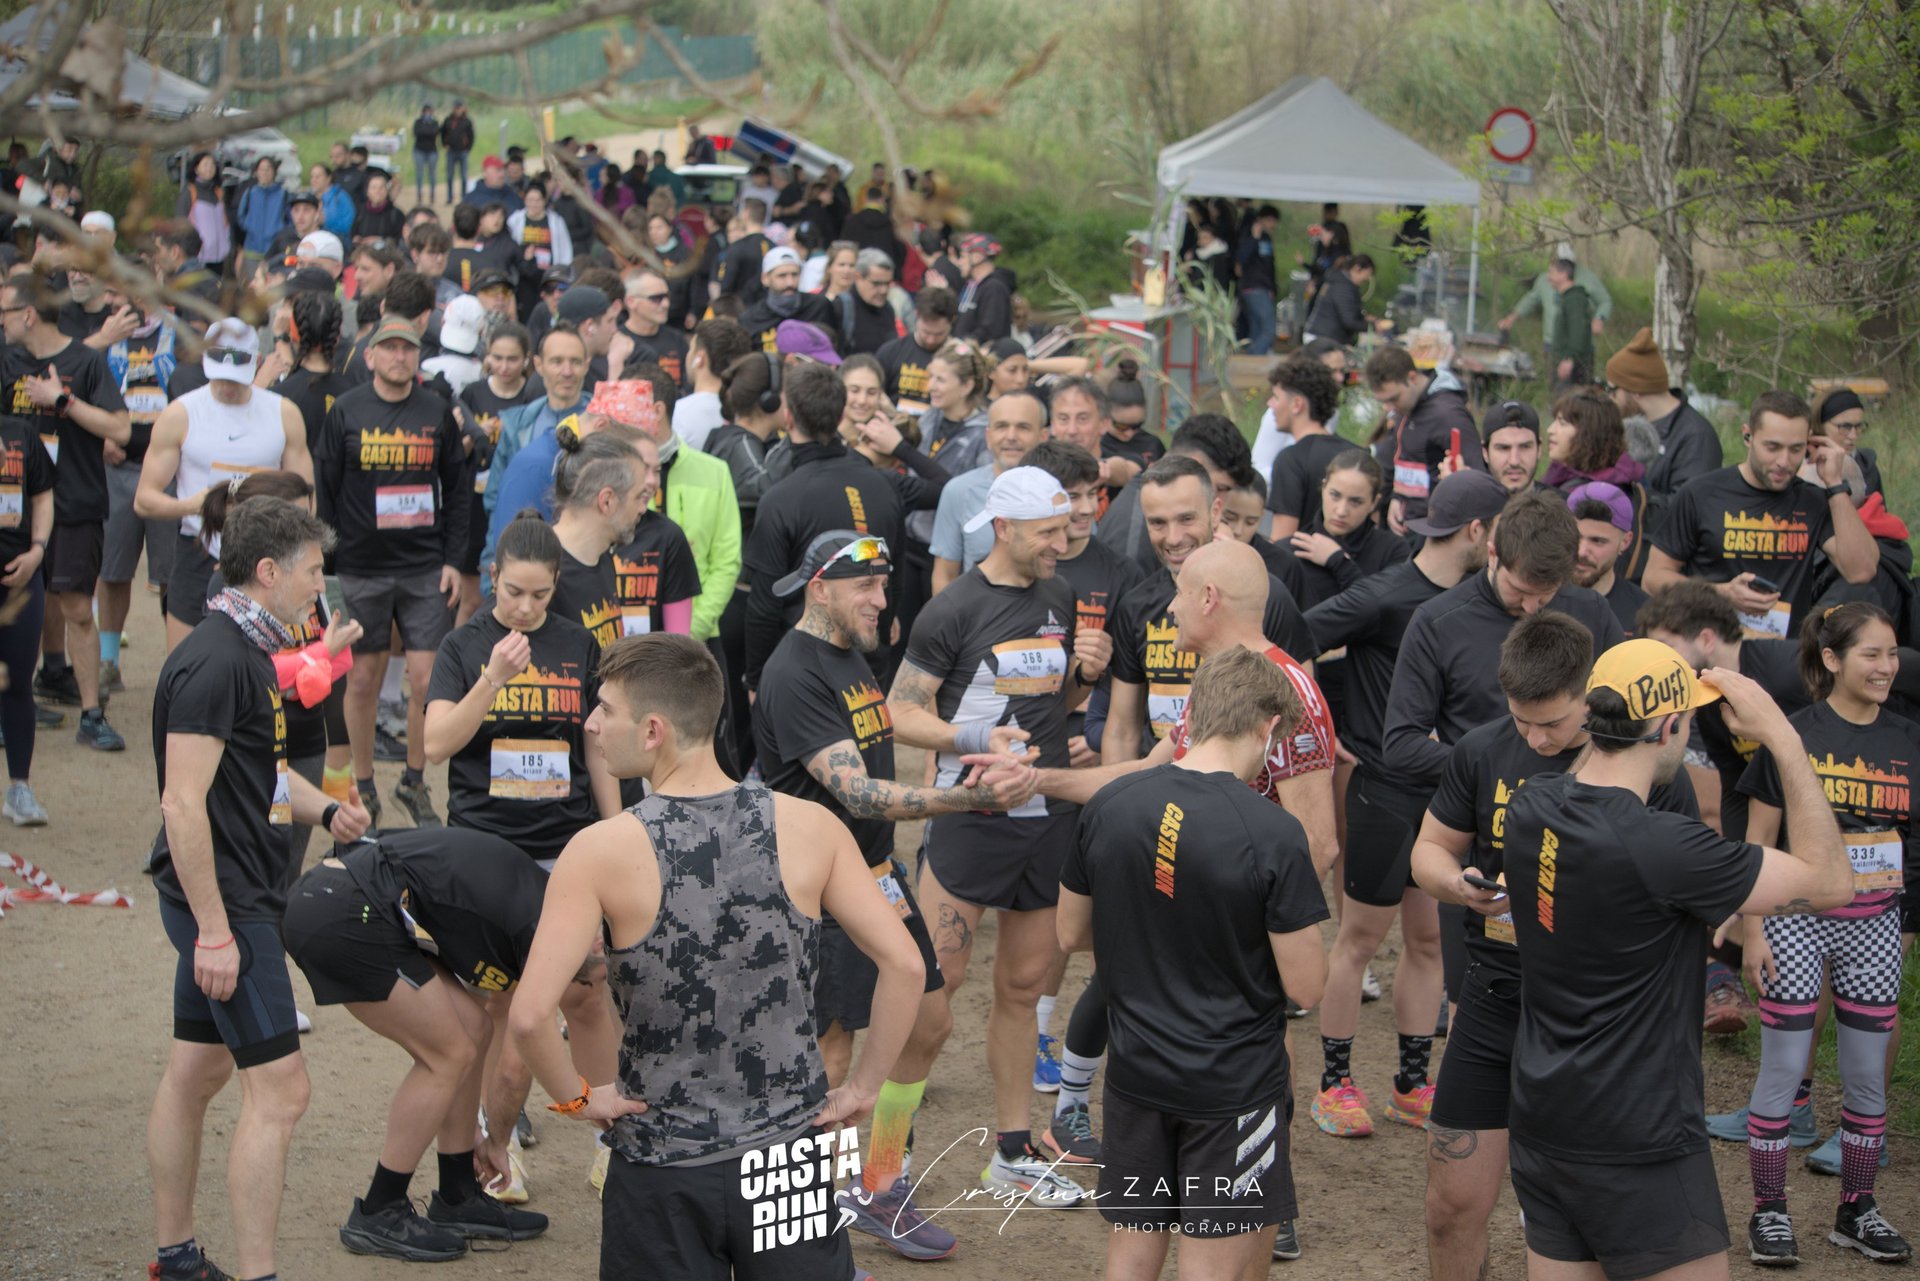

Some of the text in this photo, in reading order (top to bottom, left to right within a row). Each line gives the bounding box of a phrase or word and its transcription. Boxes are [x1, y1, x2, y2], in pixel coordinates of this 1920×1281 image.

[361, 445, 434, 465] CASTA RUN
[1723, 530, 1809, 553] CASTA RUN
[625, 576, 658, 598] RUN
[1021, 651, 1043, 664] 368
[488, 687, 581, 713] ASTA RUN
[522, 754, 543, 767] 185
[1822, 778, 1910, 812] ASTA RUN
[1154, 802, 1184, 899] CASTA RUN
[1851, 847, 1875, 860] 339
[1537, 827, 1559, 934] CASTA RUN
